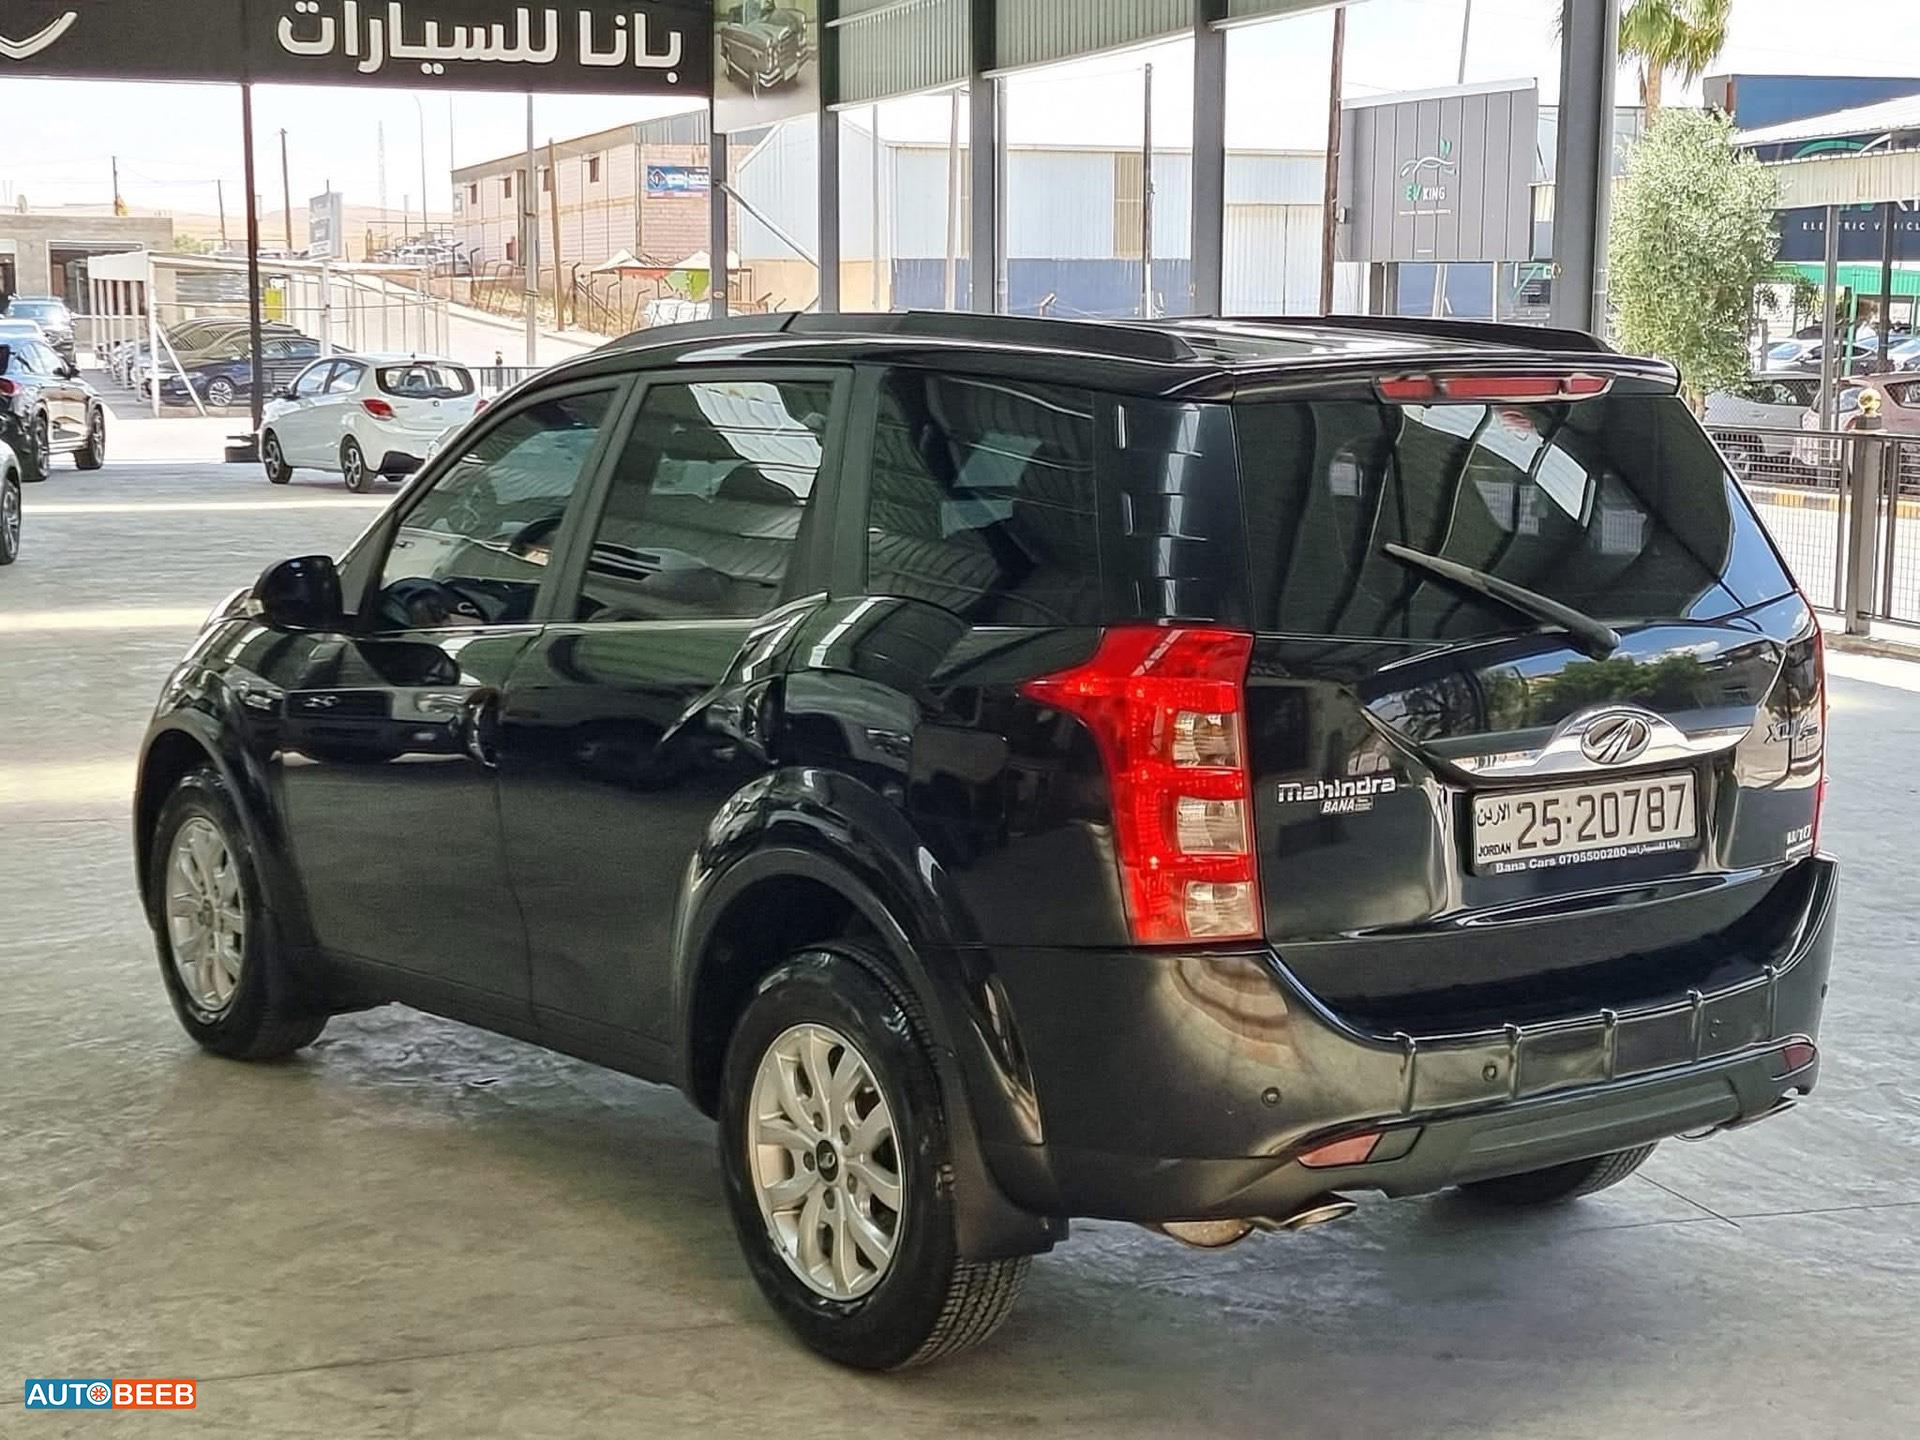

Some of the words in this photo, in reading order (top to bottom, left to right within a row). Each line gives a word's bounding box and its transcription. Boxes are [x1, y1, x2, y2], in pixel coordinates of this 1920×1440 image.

[277, 0, 559, 75] للسيارات
[578, 10, 682, 83] بانا
[1422, 186, 1445, 201] KING
[1802, 221, 1866, 231] ELERIC
[1278, 776, 1396, 803] Mahindra
[1322, 799, 1355, 814] BANA
[1478, 841, 1512, 858] JORDAN
[1495, 862, 1527, 874] Bana
[1529, 857, 1556, 869] Cars
